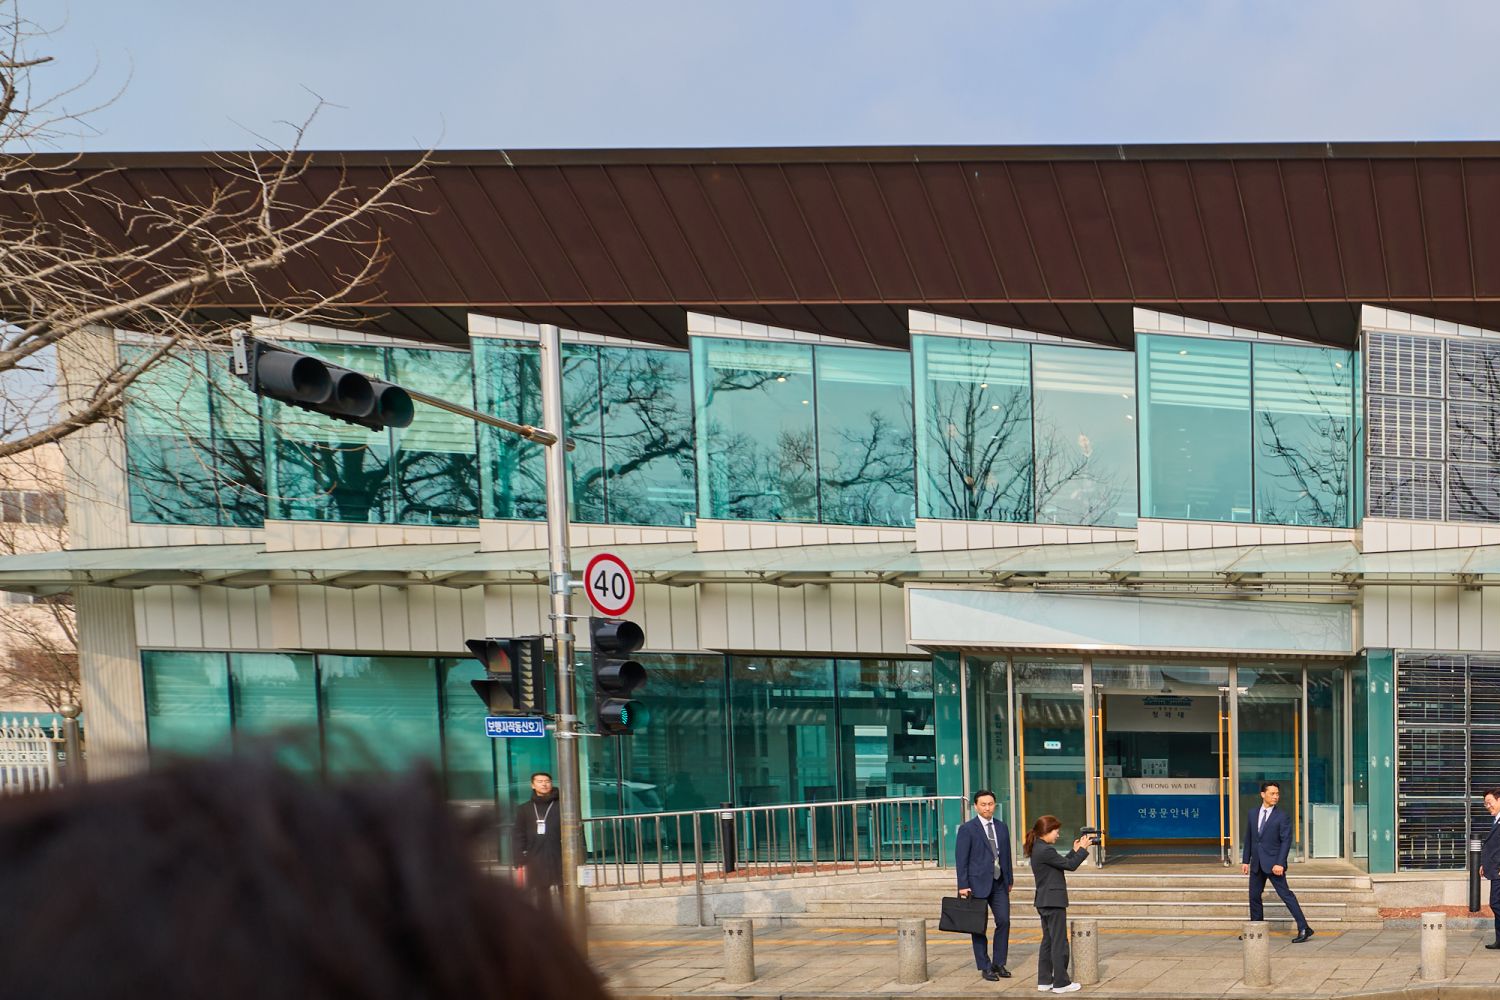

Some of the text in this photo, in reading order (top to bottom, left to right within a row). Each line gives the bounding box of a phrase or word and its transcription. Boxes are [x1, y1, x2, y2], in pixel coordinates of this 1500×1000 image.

[594, 570, 625, 600] 40
[488, 721, 542, 733] 보행자작동신호기
[1138, 808, 1200, 819] 연풍문안내실
